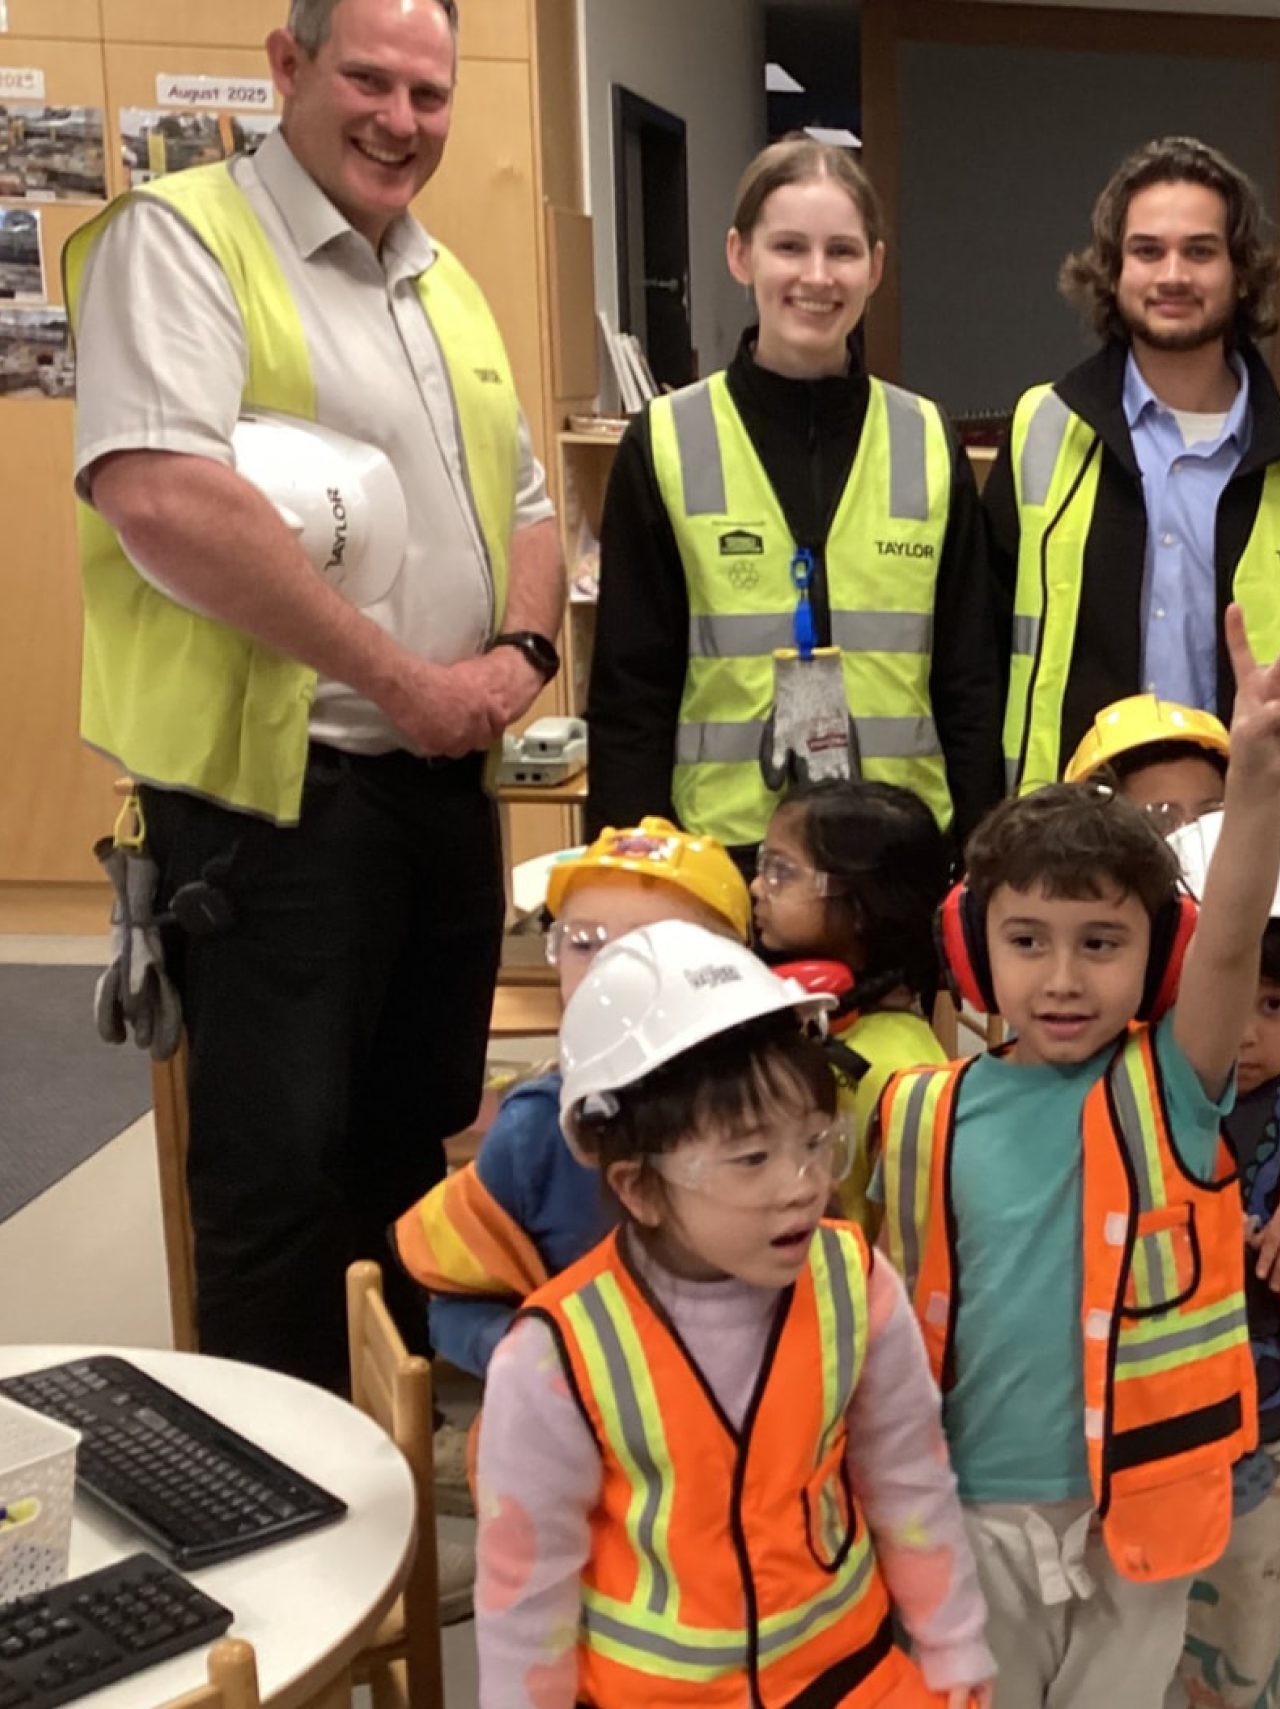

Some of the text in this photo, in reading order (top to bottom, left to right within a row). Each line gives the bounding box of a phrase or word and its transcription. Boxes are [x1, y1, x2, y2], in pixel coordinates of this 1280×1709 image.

[168, 84, 267, 103] August 2025
[323, 487, 347, 572] TAYLOR
[874, 540, 934, 558] TAYLOR
